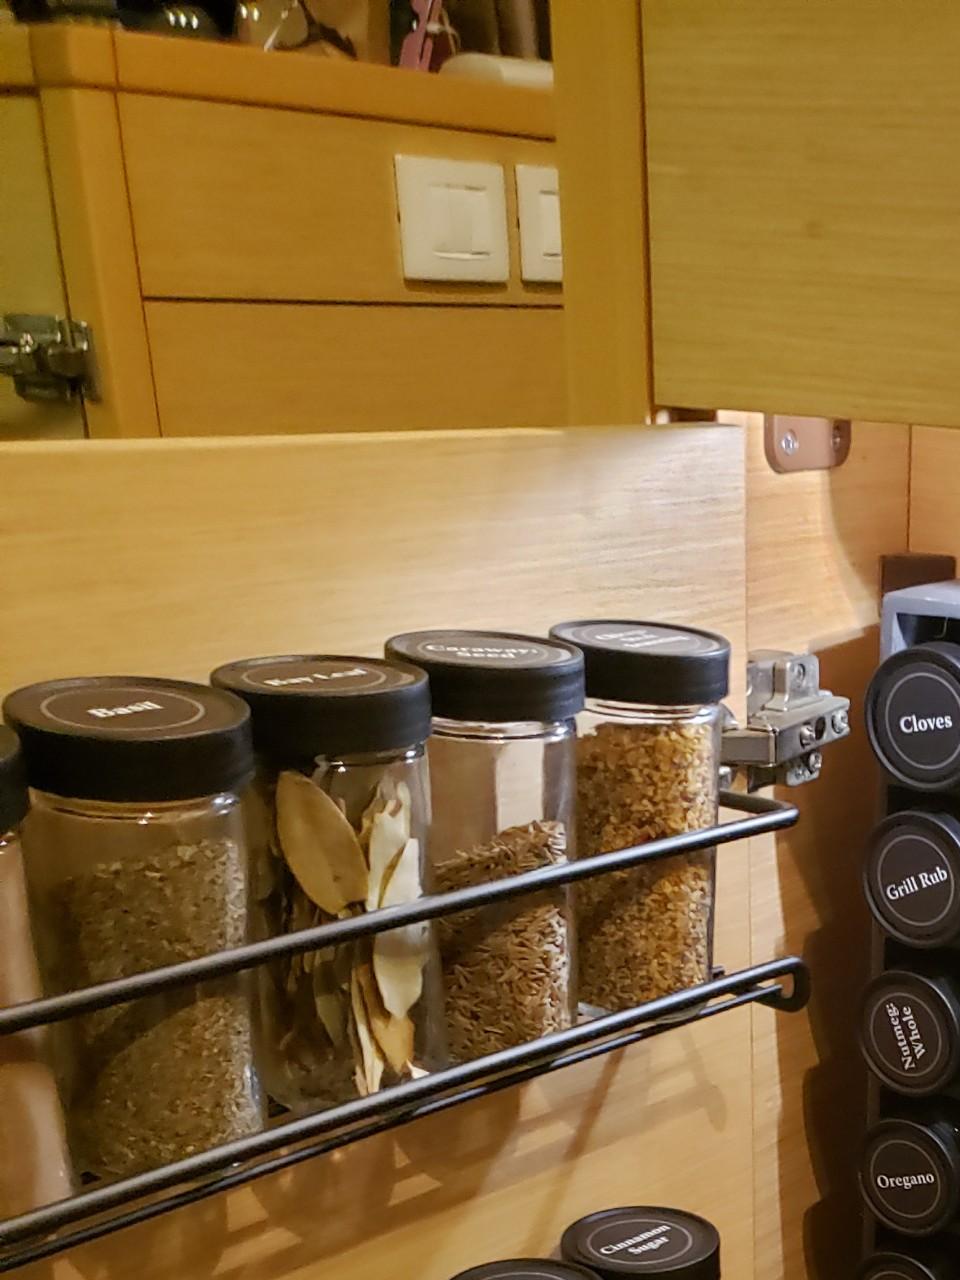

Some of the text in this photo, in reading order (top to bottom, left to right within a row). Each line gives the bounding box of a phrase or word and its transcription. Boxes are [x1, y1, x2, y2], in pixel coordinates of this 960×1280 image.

[87, 700, 164, 718] Basil
[900, 715, 953, 734] Cloves
[886, 866, 948, 900] Grill Rub
[903, 1006, 926, 1059] Whole
[877, 1173, 934, 1189] Oregano
[600, 1223, 671, 1256] Cinnamon
[628, 1234, 670, 1256] Sugar
